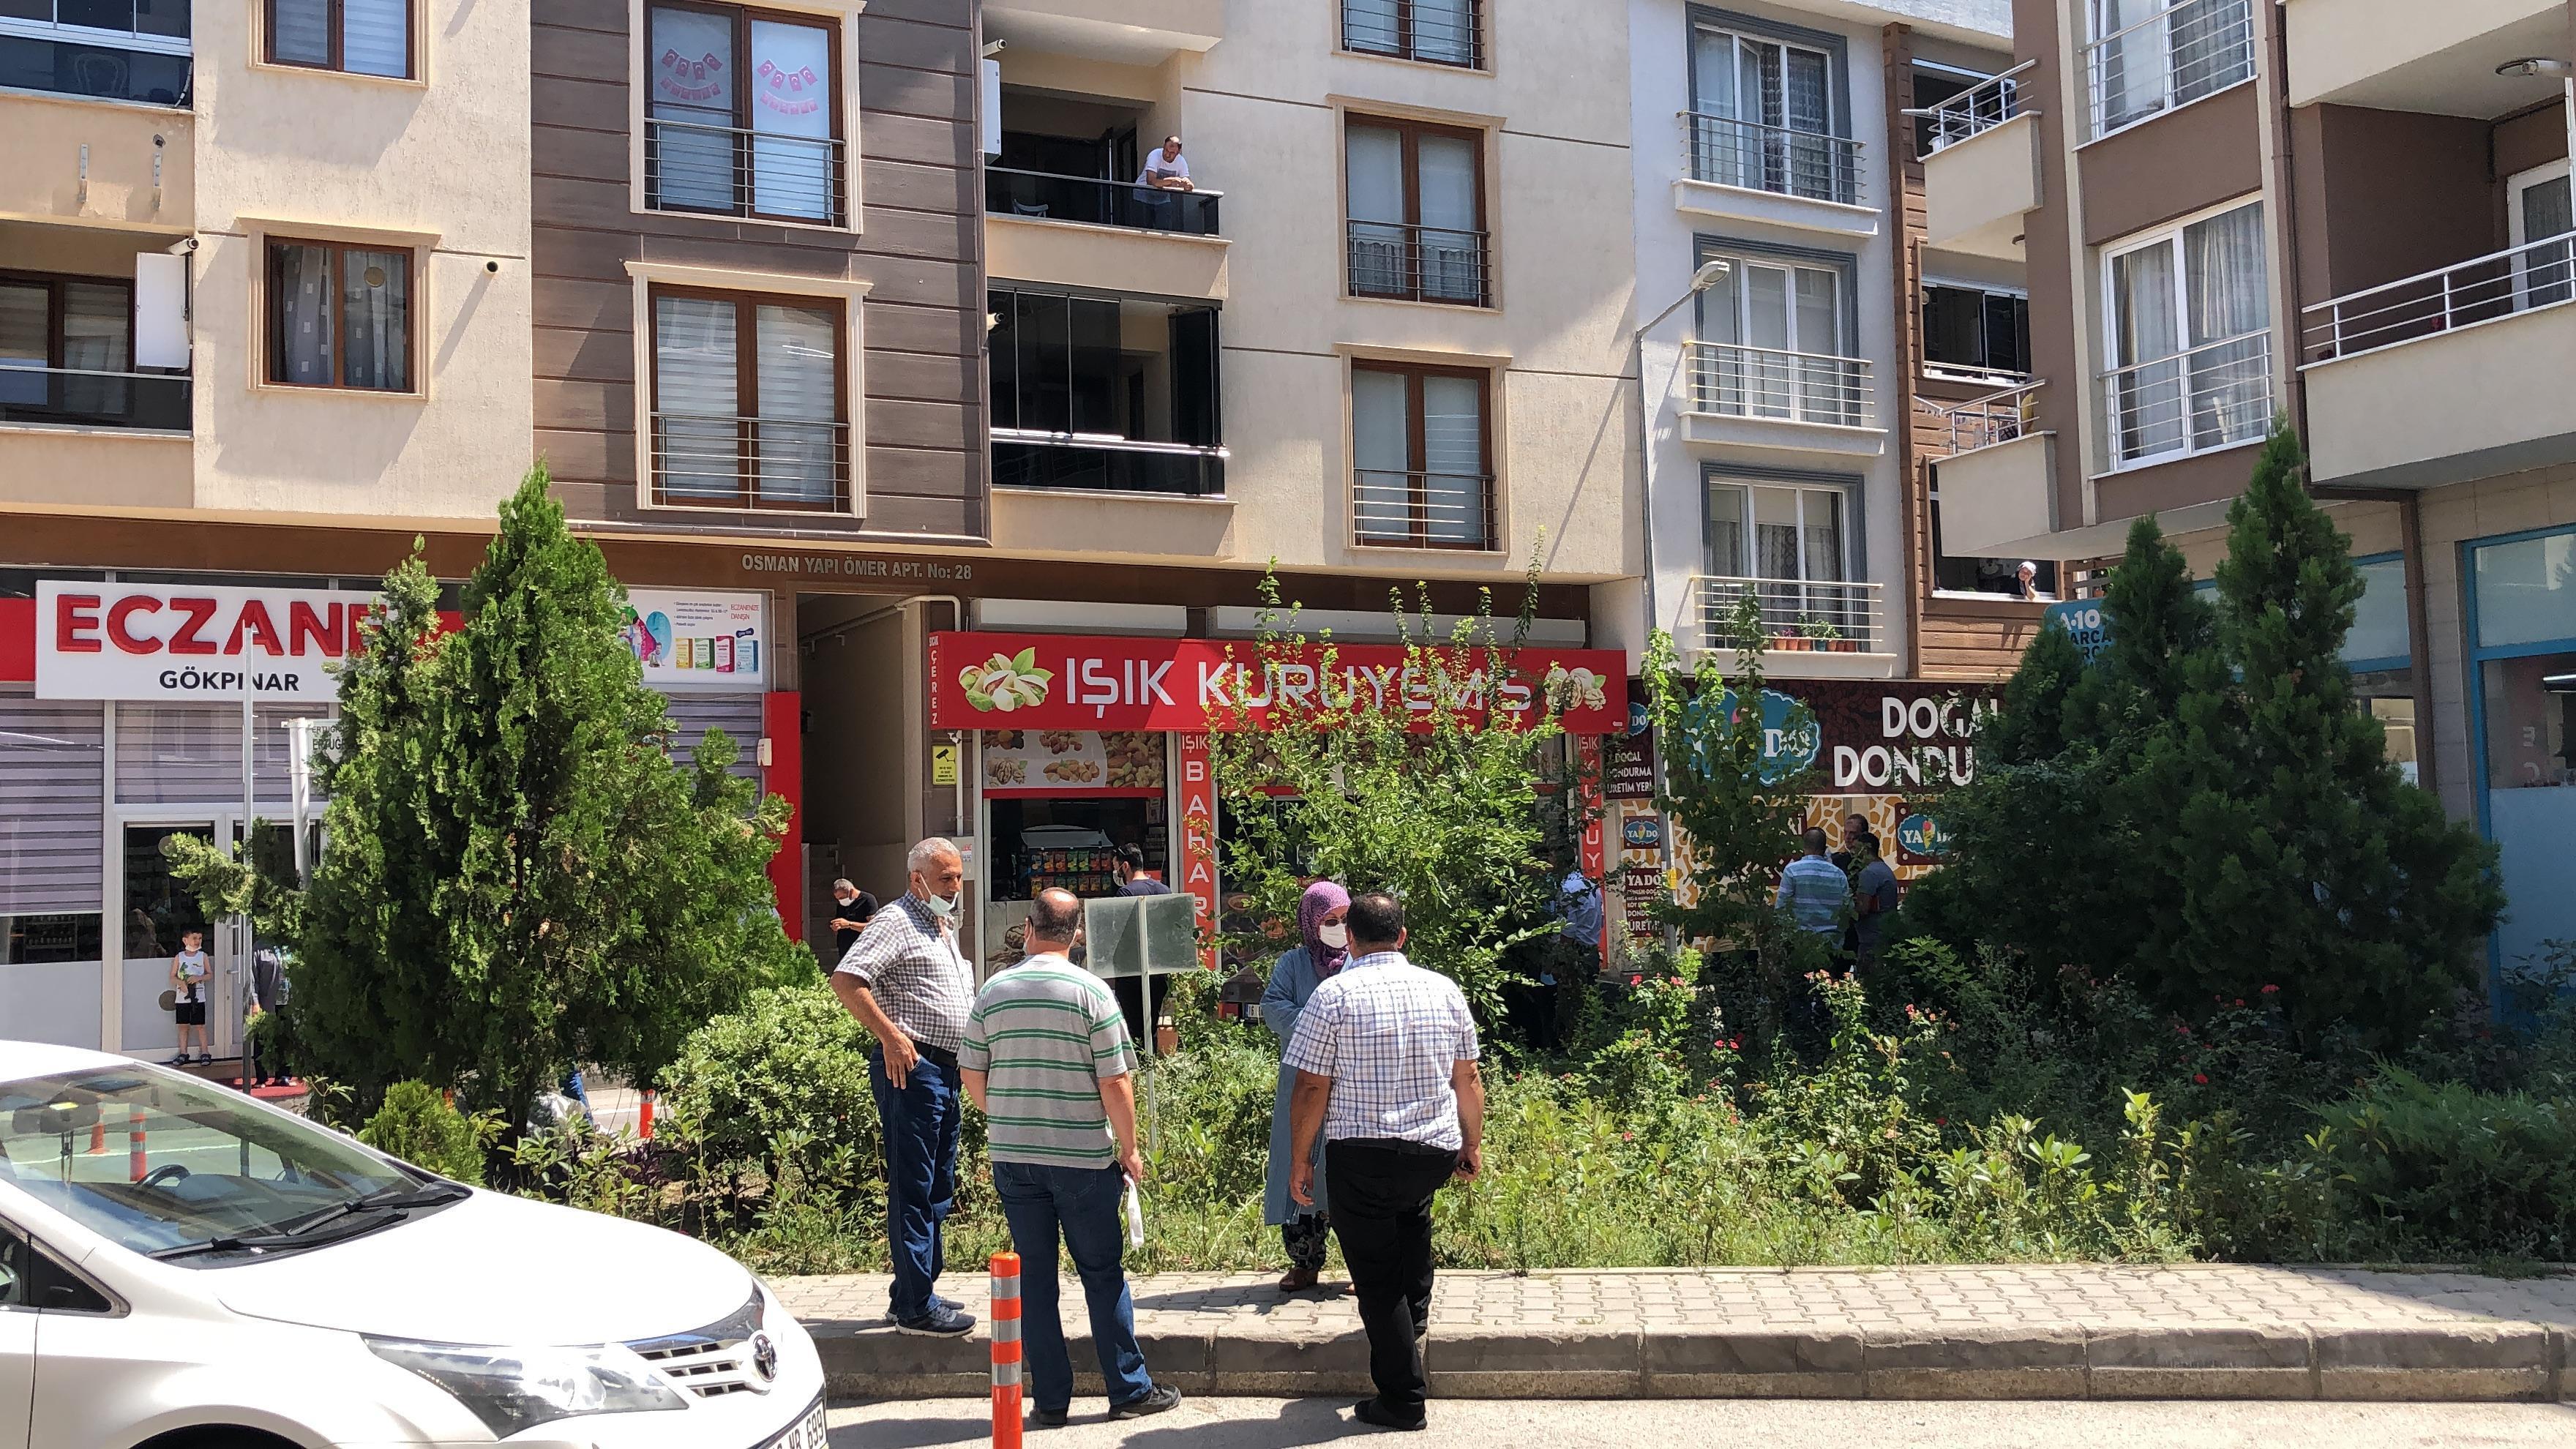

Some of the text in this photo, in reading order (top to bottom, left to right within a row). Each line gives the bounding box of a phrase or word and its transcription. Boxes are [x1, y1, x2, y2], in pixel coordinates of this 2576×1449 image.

[741, 554, 973, 580] OSMAN YAPI ÖMER APT. No: 28
[2070, 630, 2112, 645] ARCA
[159, 666, 299, 692] GÖKPINAR
[1066, 657, 1532, 719] IŞIK KURUYEMŞ
[1181, 735, 1209, 754] IŞIK
[1579, 735, 1598, 754] IŞIK
[1833, 745, 1974, 787] DONDU
[806, 1408, 824, 1449] 699
